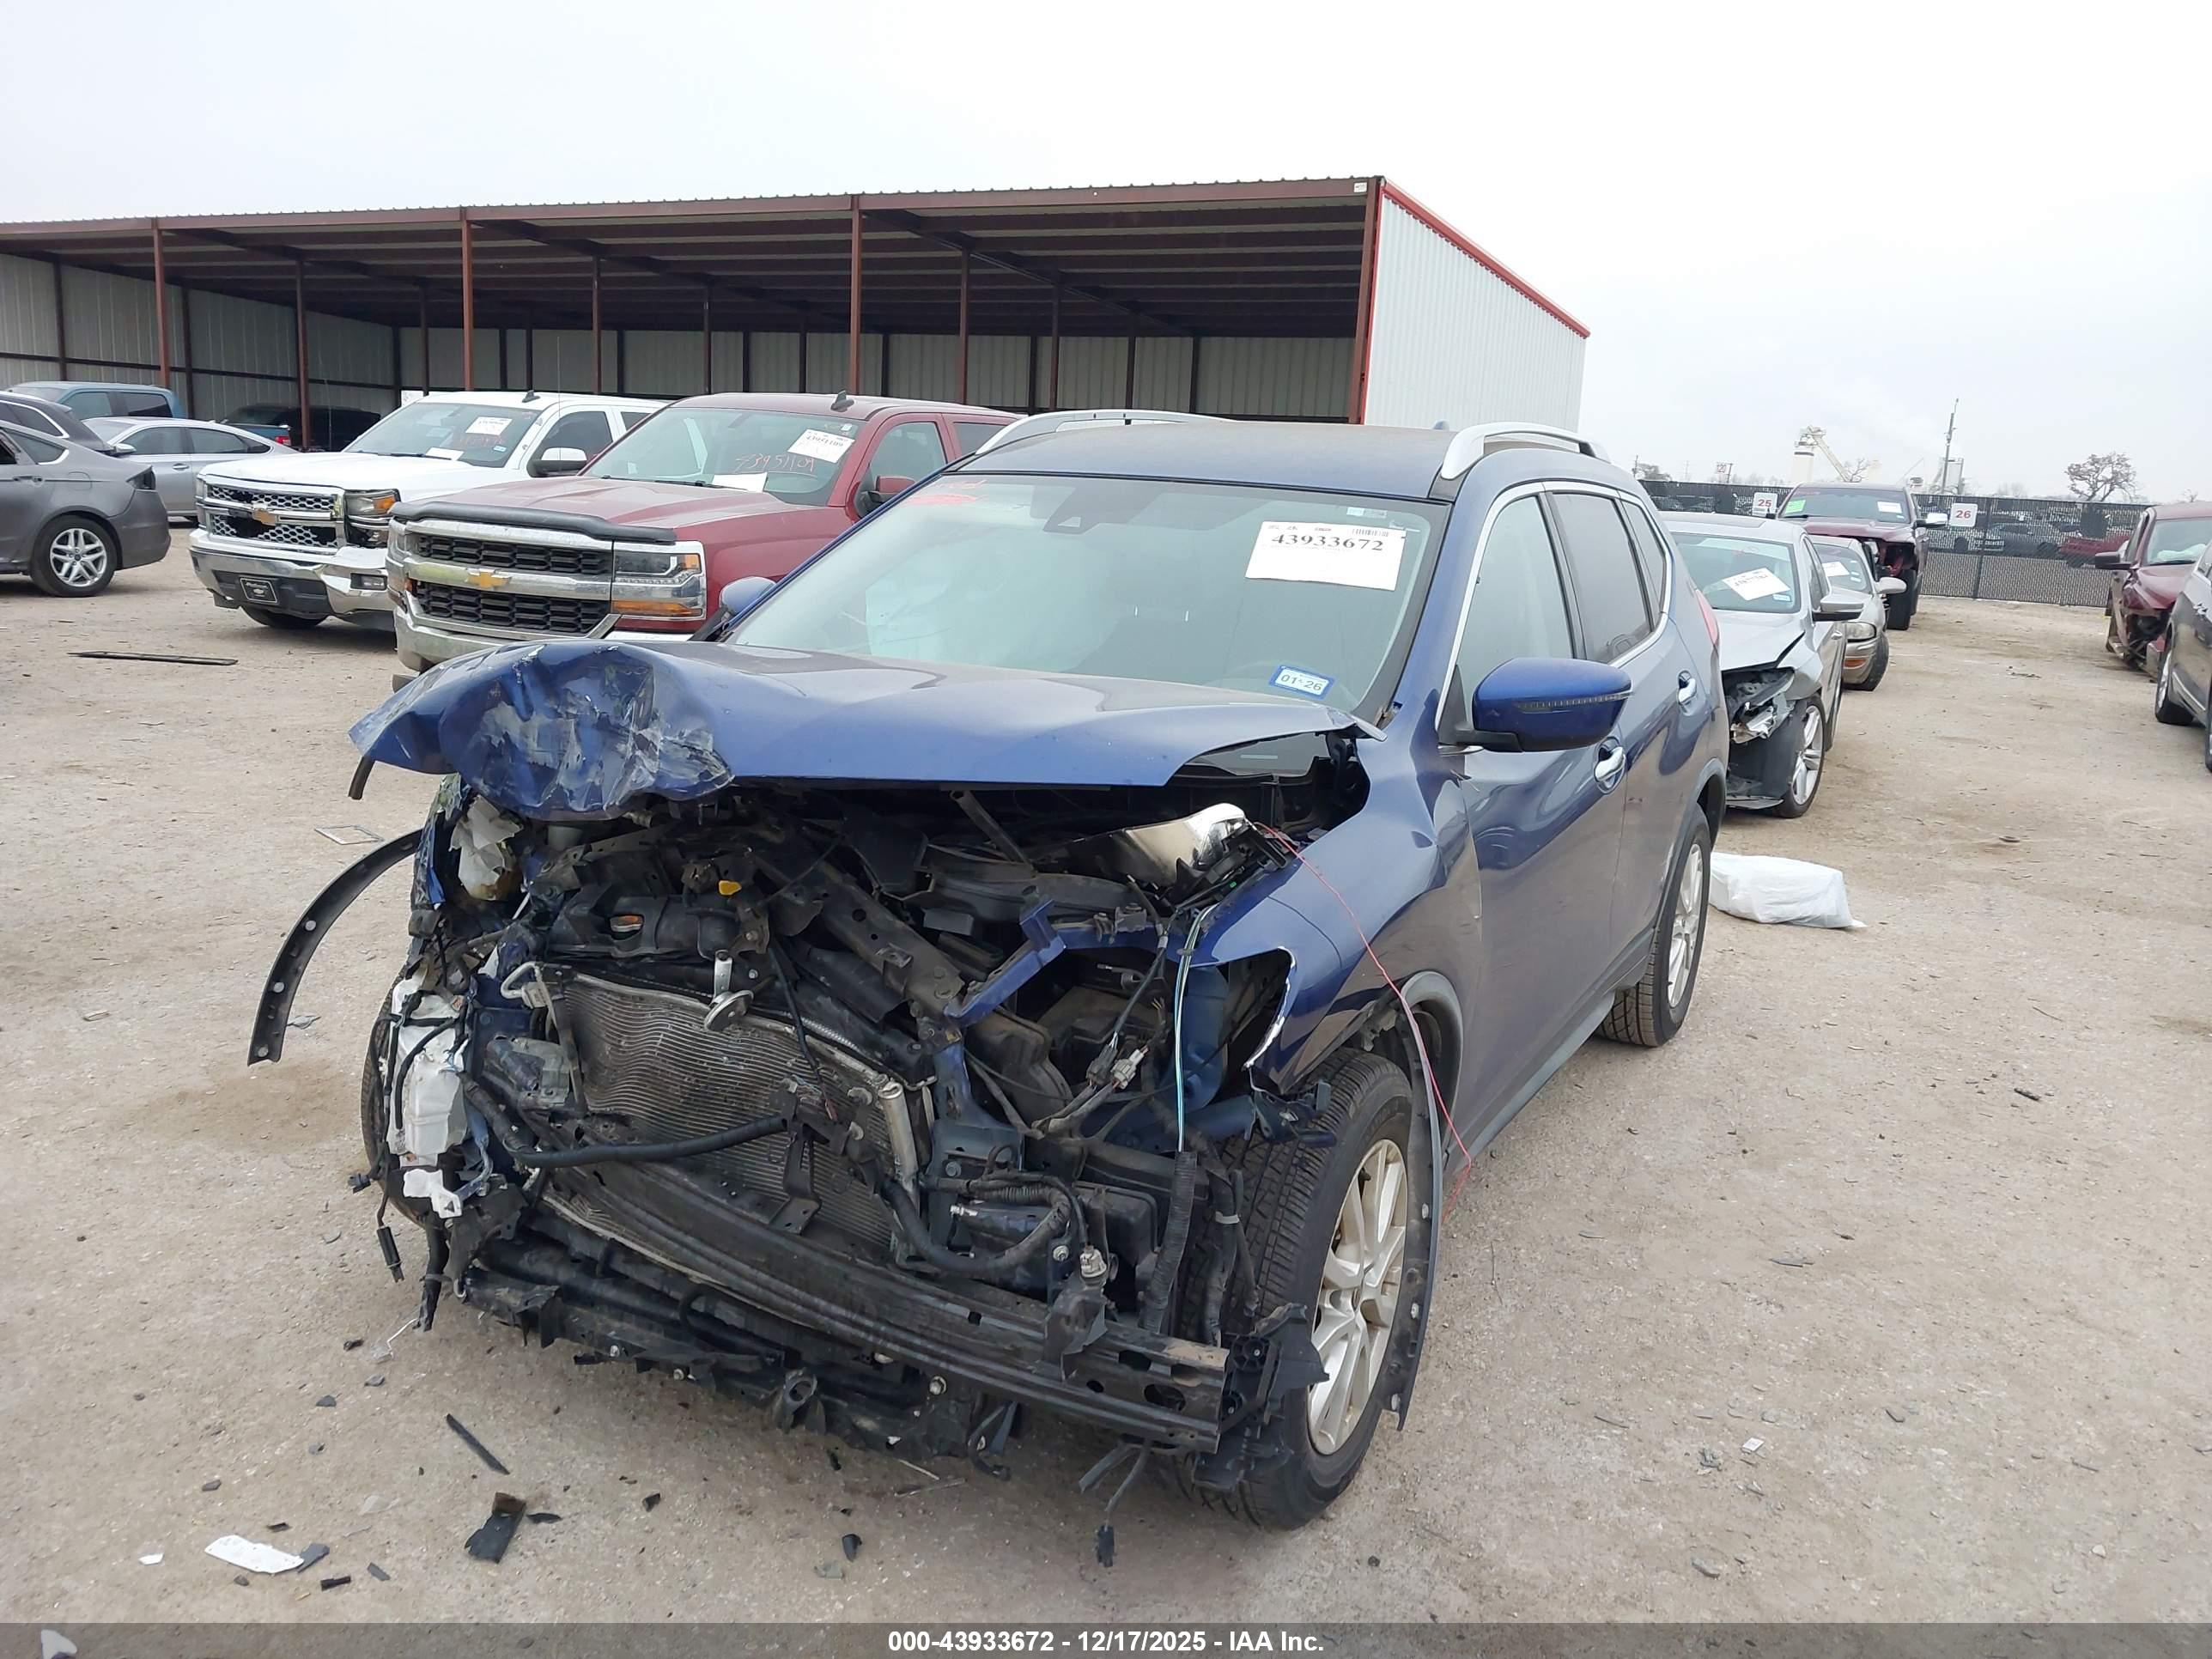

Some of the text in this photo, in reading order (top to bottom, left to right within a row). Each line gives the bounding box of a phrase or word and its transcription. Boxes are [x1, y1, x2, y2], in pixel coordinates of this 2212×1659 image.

[1758, 499, 1772, 507] 25
[1955, 510, 1972, 519] 26
[1272, 533, 1383, 551] 43933672
